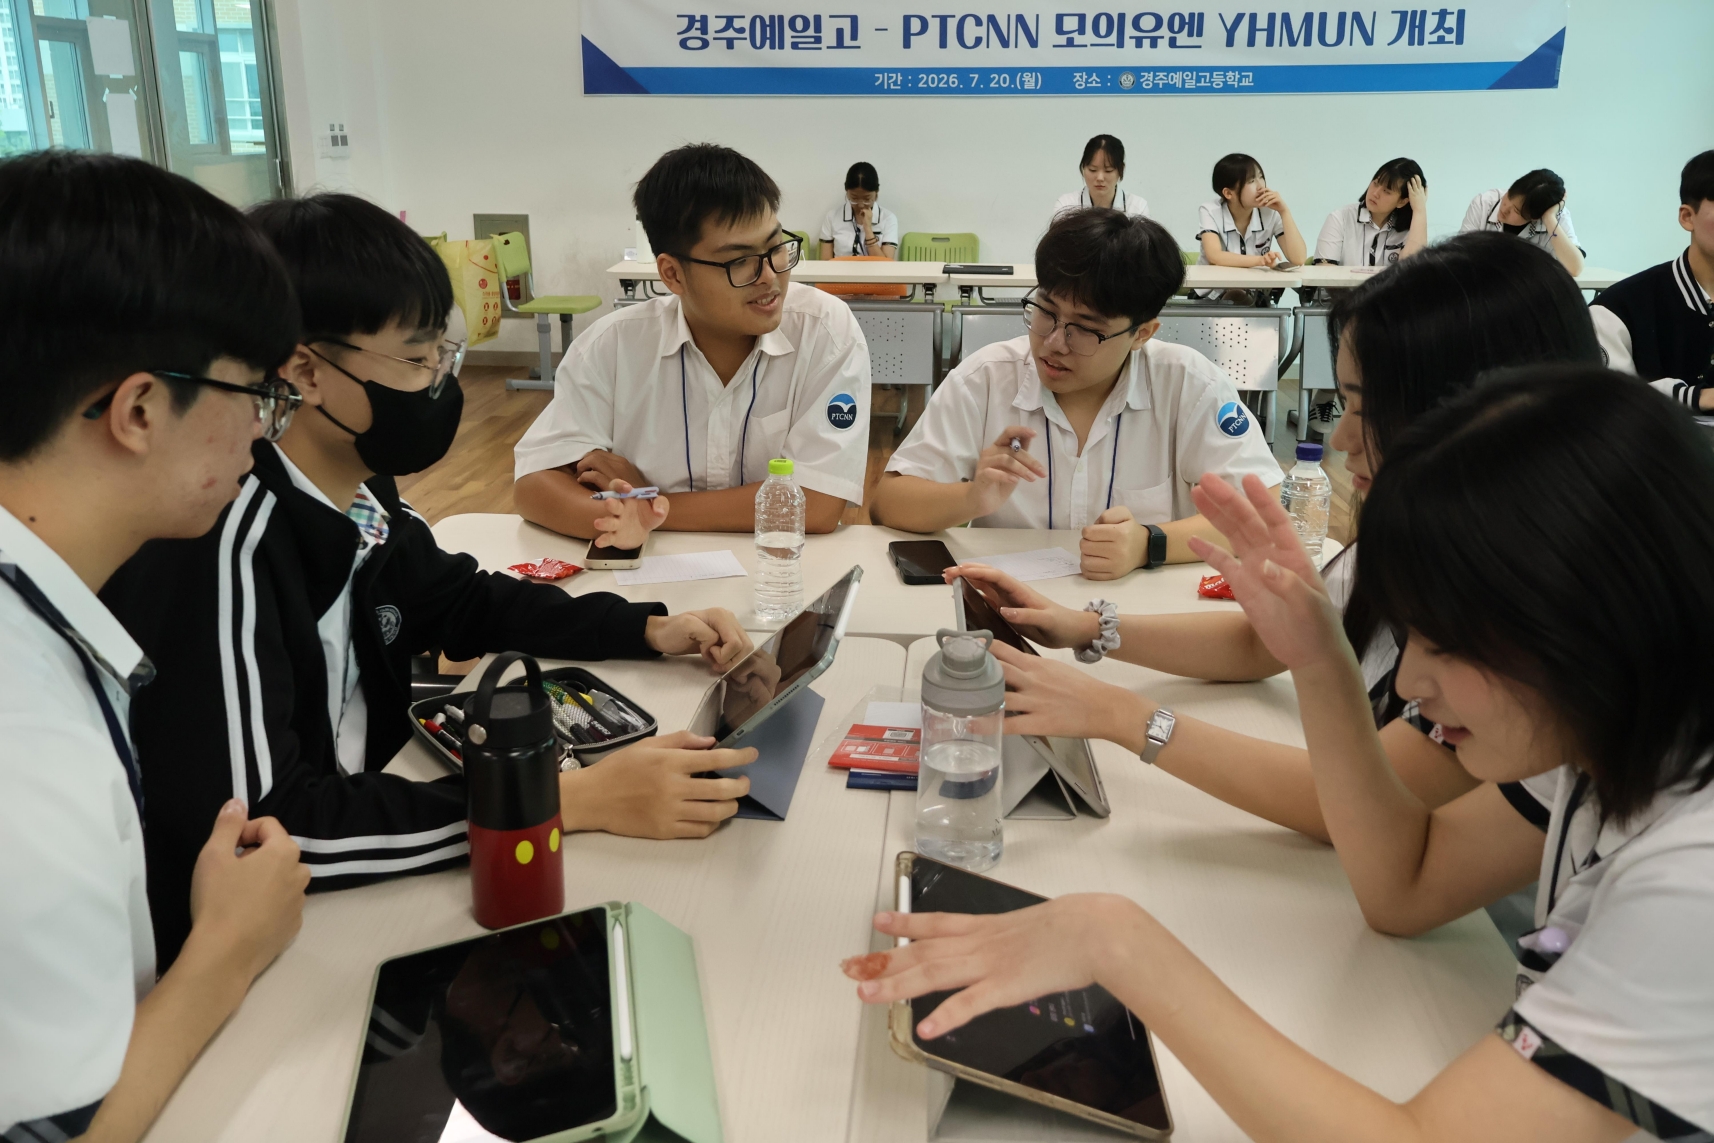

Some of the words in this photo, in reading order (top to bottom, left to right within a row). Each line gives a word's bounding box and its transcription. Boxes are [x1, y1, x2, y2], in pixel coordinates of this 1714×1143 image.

[676, 13, 862, 51] 경주예일고
[902, 13, 1040, 50] PTCNN
[1052, 11, 1205, 49] 모의유엔
[1217, 10, 1377, 48] YHMUN
[1386, 8, 1467, 47] 개최
[874, 72, 903, 90] 기간
[917, 73, 964, 89] 2026.
[969, 73, 984, 89] 7.
[989, 72, 1042, 90] 20.(월)
[1072, 71, 1102, 90] 장소
[1139, 70, 1255, 89] 경주예일고등학교
[831, 413, 854, 421] PTCNN
[1227, 412, 1248, 433] PTCNN
